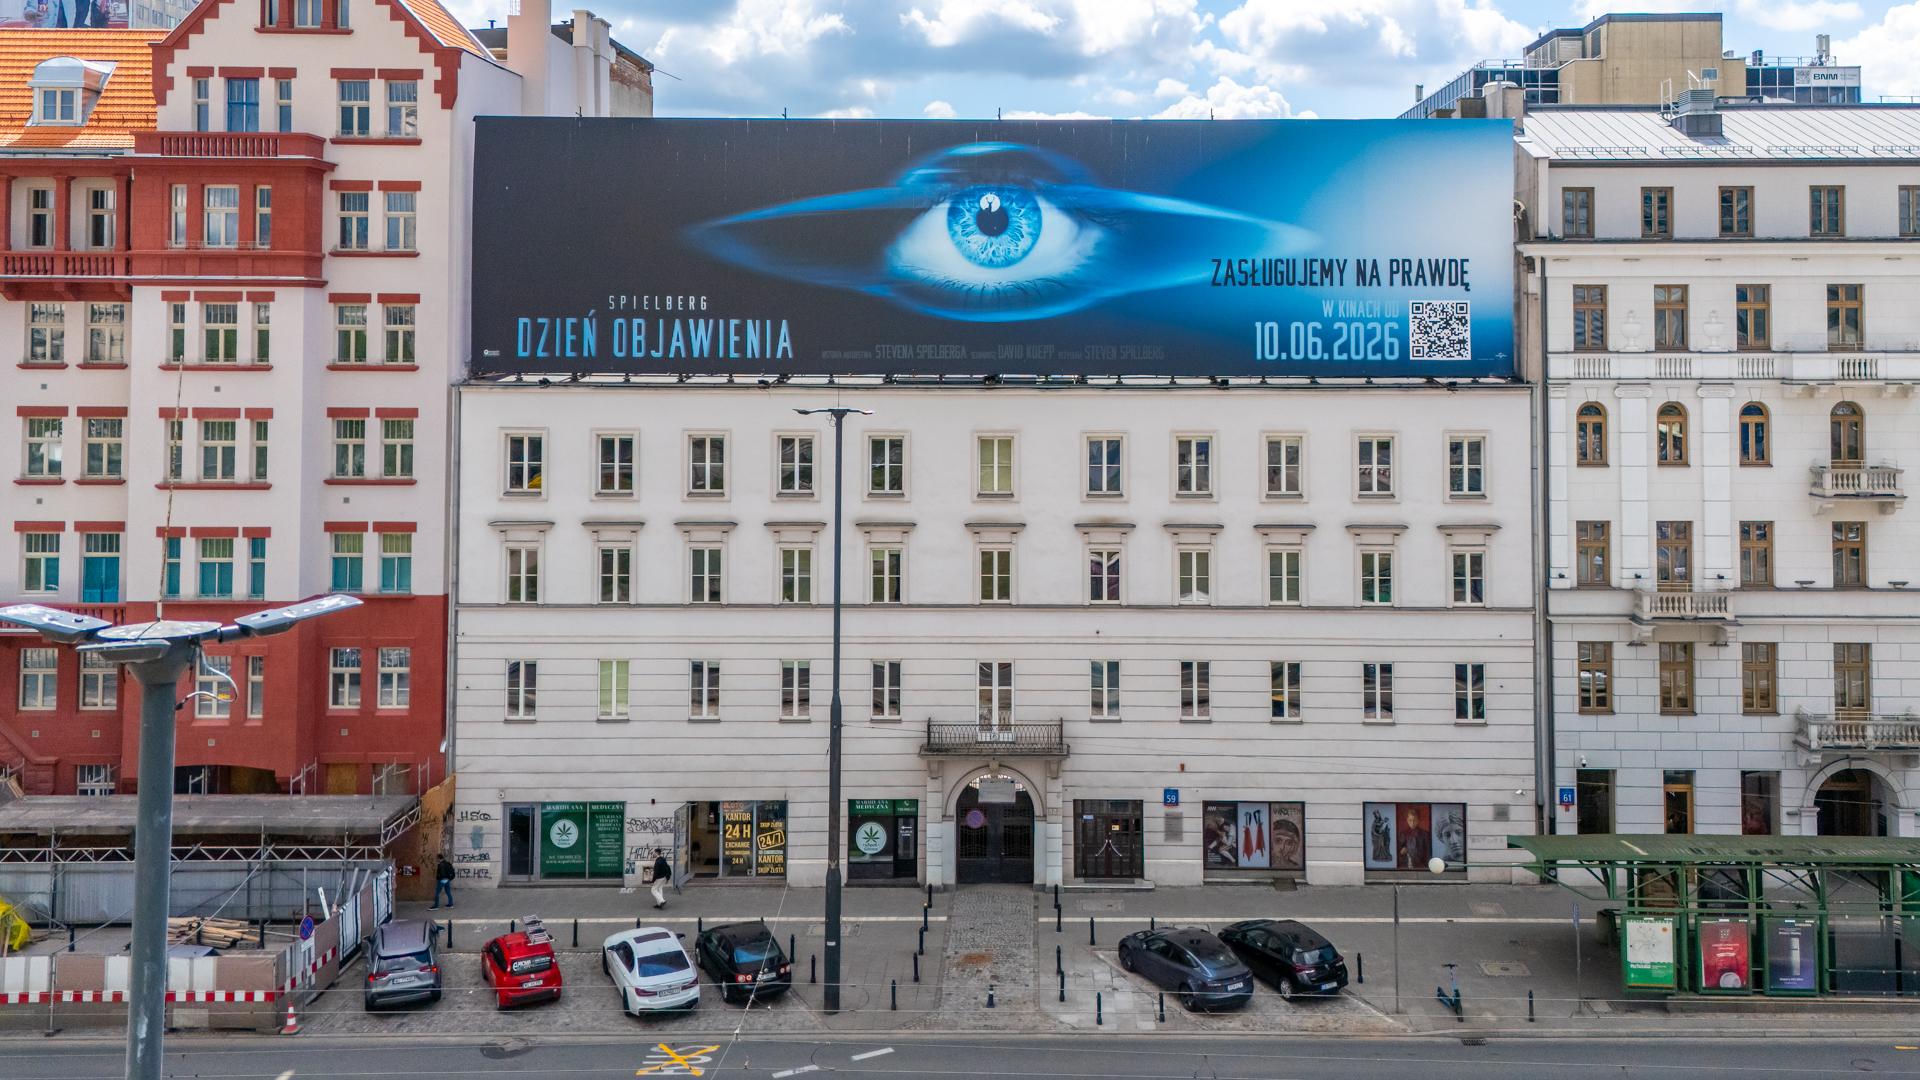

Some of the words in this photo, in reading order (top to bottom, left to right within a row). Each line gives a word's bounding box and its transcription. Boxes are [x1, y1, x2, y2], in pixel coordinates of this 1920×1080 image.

[1211, 258, 1348, 287] ZASŁUGUJEMY
[1356, 258, 1381, 287] NA
[1389, 258, 1470, 291] PRAWDĘ
[608, 295, 708, 311] SPIELBERG
[1322, 300, 1335, 318] W
[1339, 300, 1381, 318] KINACH
[1384, 301, 1399, 318] OD
[517, 309, 598, 358] DZIEŃ
[613, 318, 794, 359] OBJAWIENIA
[1255, 321, 1400, 361] 10.06.2026
[875, 344, 914, 360] STEVENA
[916, 344, 967, 360] SPIELBERGA
[998, 344, 1023, 360] DAVID
[1166, 794, 1176, 803] 59
[1563, 794, 1572, 802] 61
[726, 812, 751, 821] KANTOR
[726, 824, 740, 838] 24
[743, 824, 751, 838] H
[760, 833, 781, 848] 24/7
[758, 855, 783, 863] KANTOR
